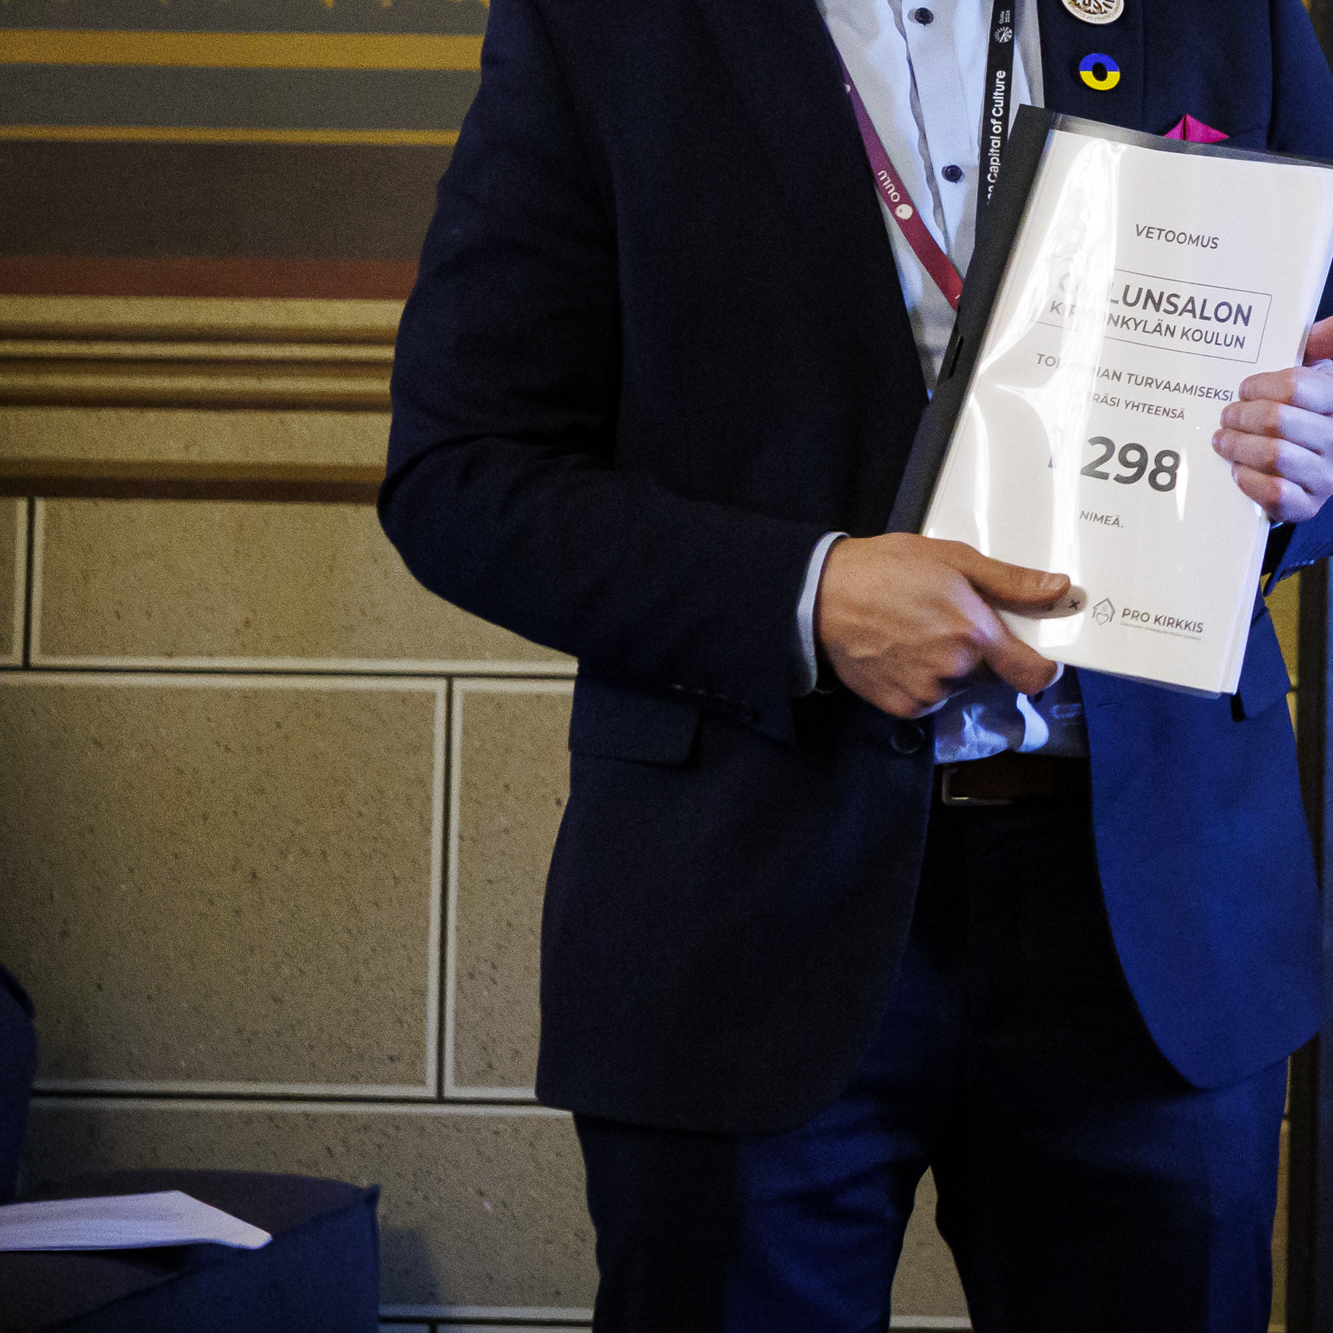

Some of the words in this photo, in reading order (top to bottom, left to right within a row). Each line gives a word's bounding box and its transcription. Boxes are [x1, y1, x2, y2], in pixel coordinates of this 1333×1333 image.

[992, 69, 1006, 117] Culture
[992, 118, 1003, 134] of
[1135, 223, 1219, 249] VETOOMUS
[1180, 329, 1246, 350] KOULUN
[1126, 372, 1234, 402] TURVAAMISEKSI
[1124, 399, 1185, 421] YHTEENSÄ
[1079, 510, 1124, 528] NIMEÄ.
[1122, 608, 1151, 623] PRO
[1153, 613, 1204, 633] KIRKKIS
